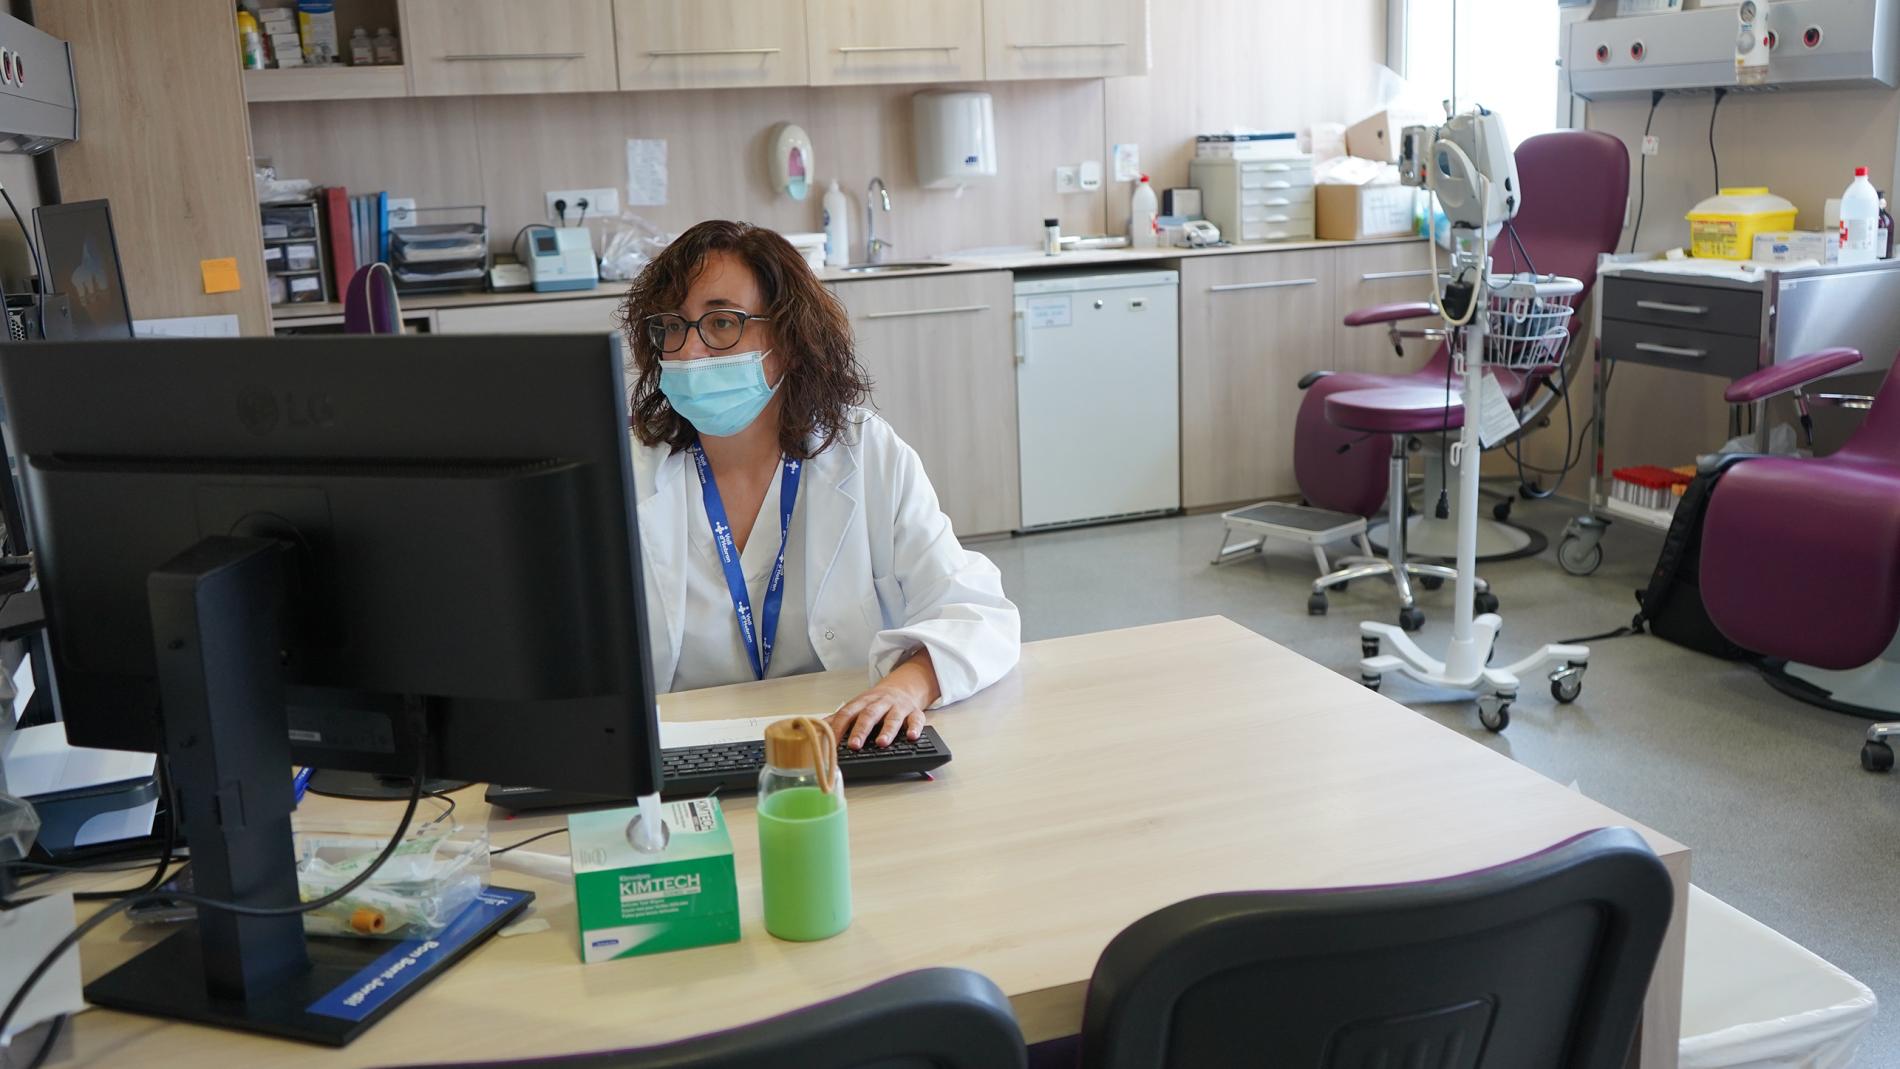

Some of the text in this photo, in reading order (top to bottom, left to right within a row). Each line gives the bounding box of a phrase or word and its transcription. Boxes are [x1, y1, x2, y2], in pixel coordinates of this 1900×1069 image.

[724, 532, 733, 546] Vall
[719, 535, 731, 564] d'Hebron
[745, 612, 753, 626] Vall
[619, 873, 700, 896] KIMTECH
